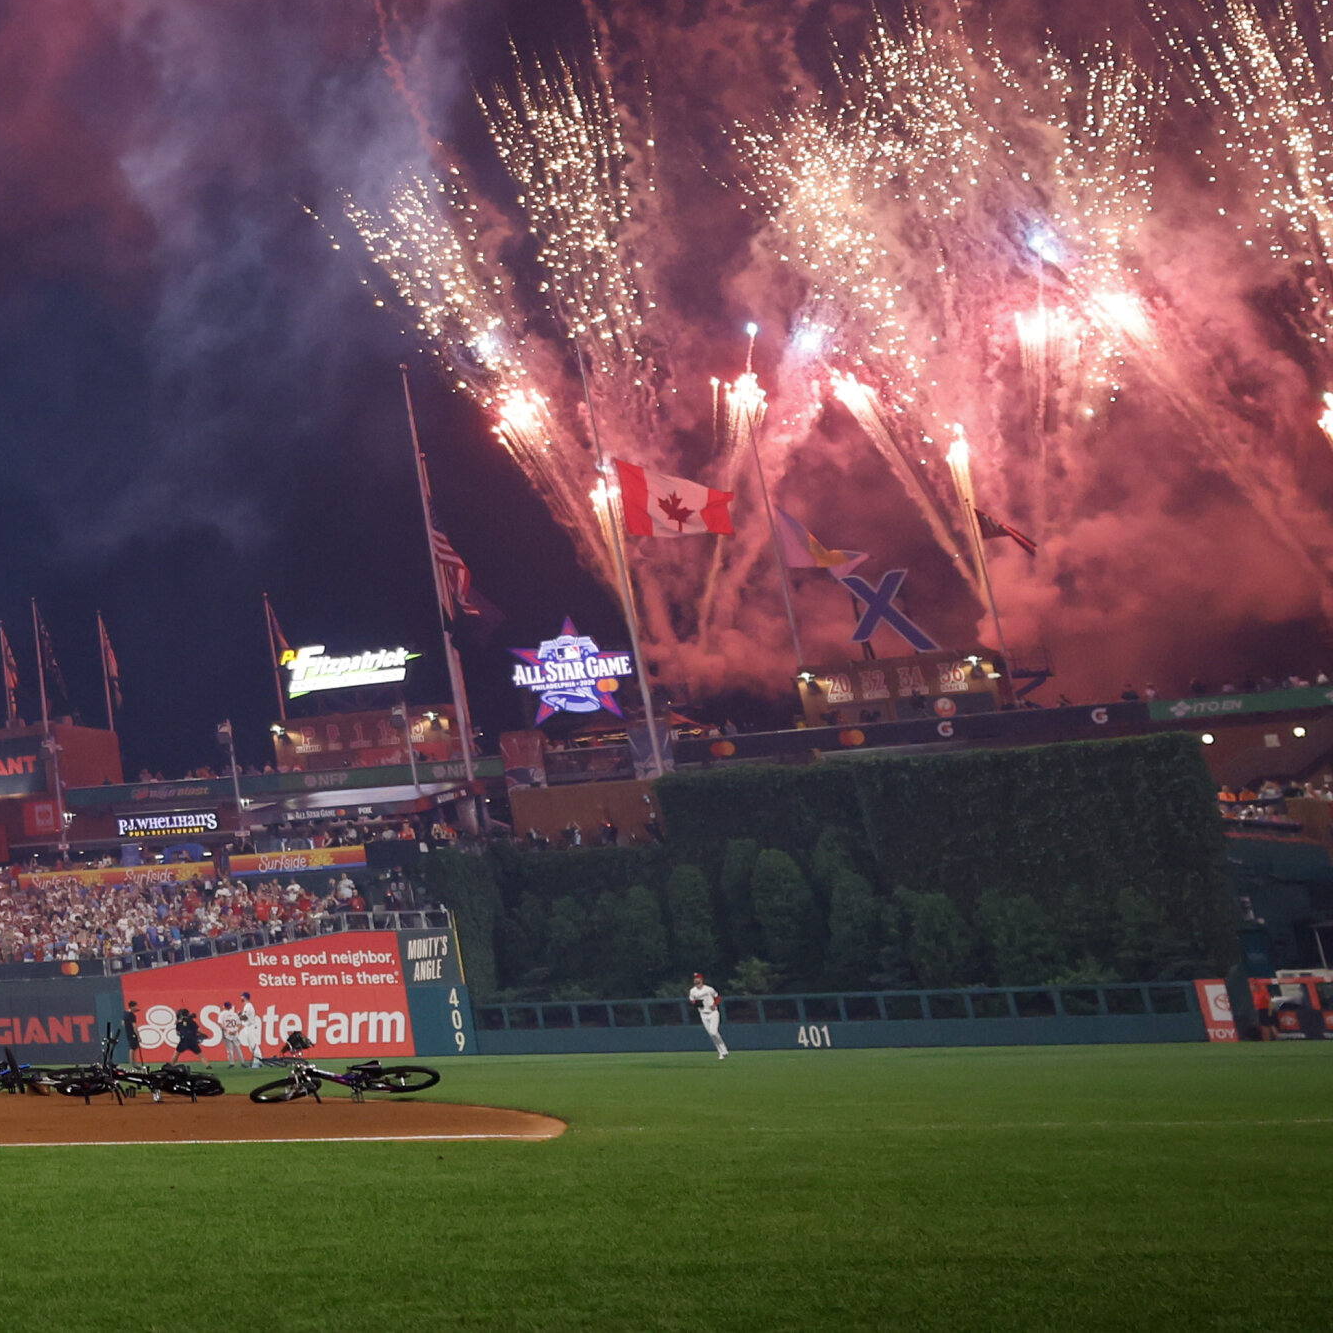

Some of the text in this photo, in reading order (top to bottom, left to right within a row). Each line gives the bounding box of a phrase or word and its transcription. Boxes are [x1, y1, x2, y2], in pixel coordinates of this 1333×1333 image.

[513, 656, 632, 686] ALL STAR GAME
[531, 681, 576, 692] PHILADELPHIA
[826, 674, 851, 694] 20
[1193, 700, 1242, 713] ITO EN
[317, 773, 347, 786] NFP
[152, 827, 204, 836] RESTAURANT
[259, 854, 307, 872] Surfside
[407, 936, 448, 960] MONTY'S
[248, 950, 395, 968] Like a good neighbor,
[258, 970, 398, 986] State Farm is there.
[413, 959, 442, 982] ANGLE
[225, 1019, 237, 1028] 20
[308, 1003, 405, 1045] Farm
[798, 1024, 832, 1048] 401
